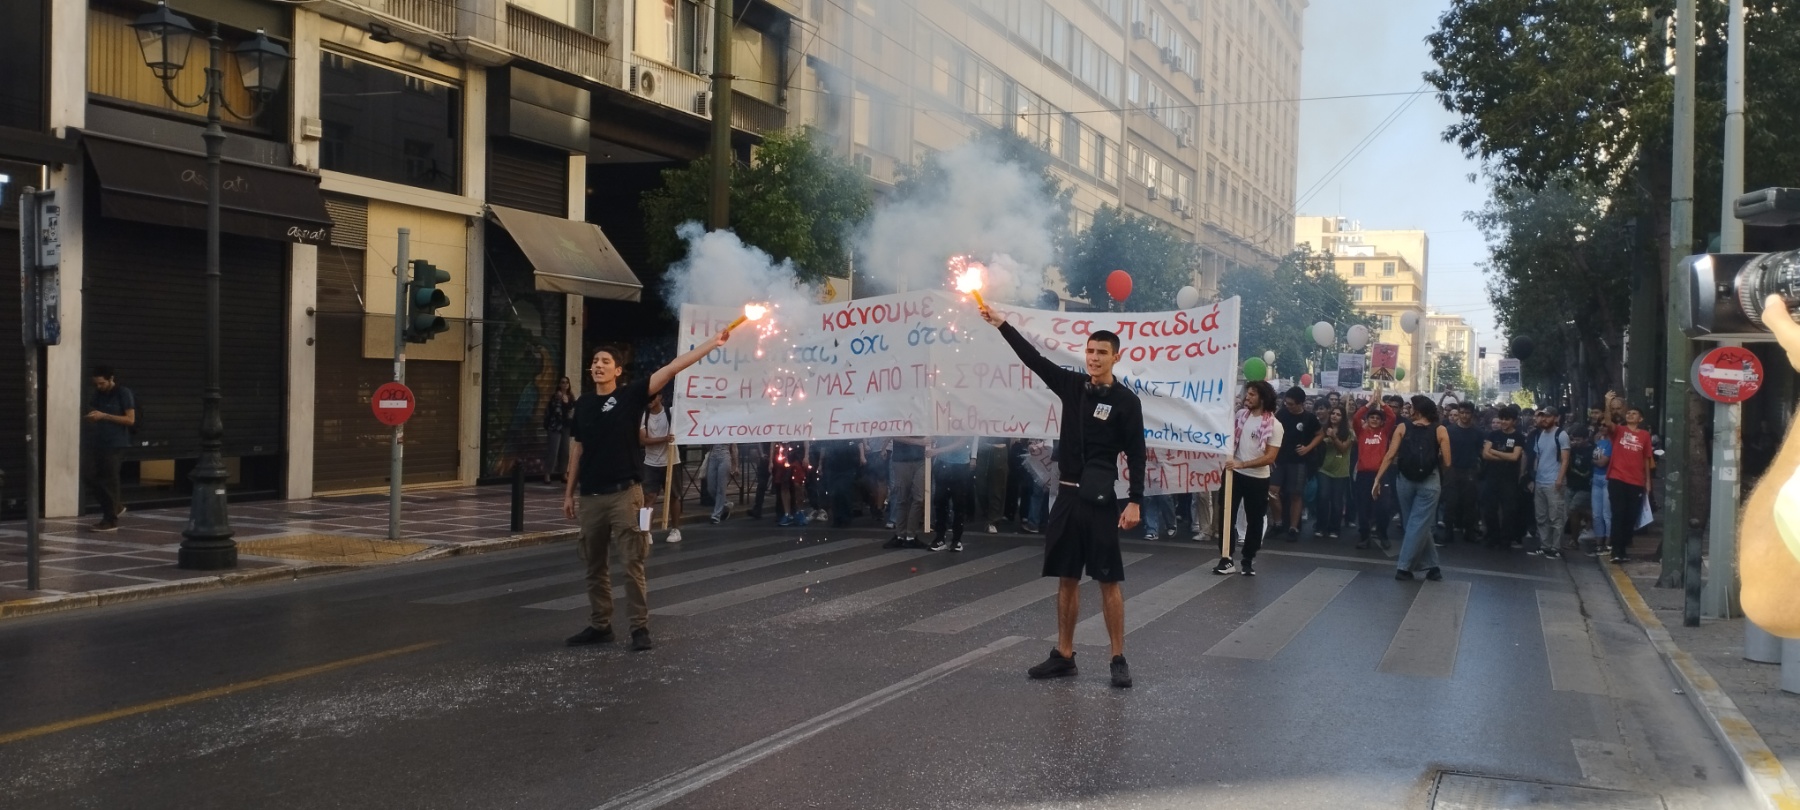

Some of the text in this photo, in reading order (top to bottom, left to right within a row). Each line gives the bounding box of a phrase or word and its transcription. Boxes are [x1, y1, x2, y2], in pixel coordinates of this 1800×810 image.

[822, 297, 934, 332] κάνουμε
[1051, 317, 1094, 336] τα
[1115, 304, 1220, 340] παιδιά
[850, 330, 889, 355] όχι
[740, 378, 752, 399] Η
[816, 371, 856, 396] ΜΑΣ
[866, 366, 902, 393] ΑΠΟ
[911, 363, 938, 388] ΤΗ
[955, 363, 1032, 390] ΣΦΑΓΗ
[687, 410, 813, 437] Συντονιστική
[828, 408, 913, 437] Επιτροπή
[935, 401, 1031, 433] Μαθητών
